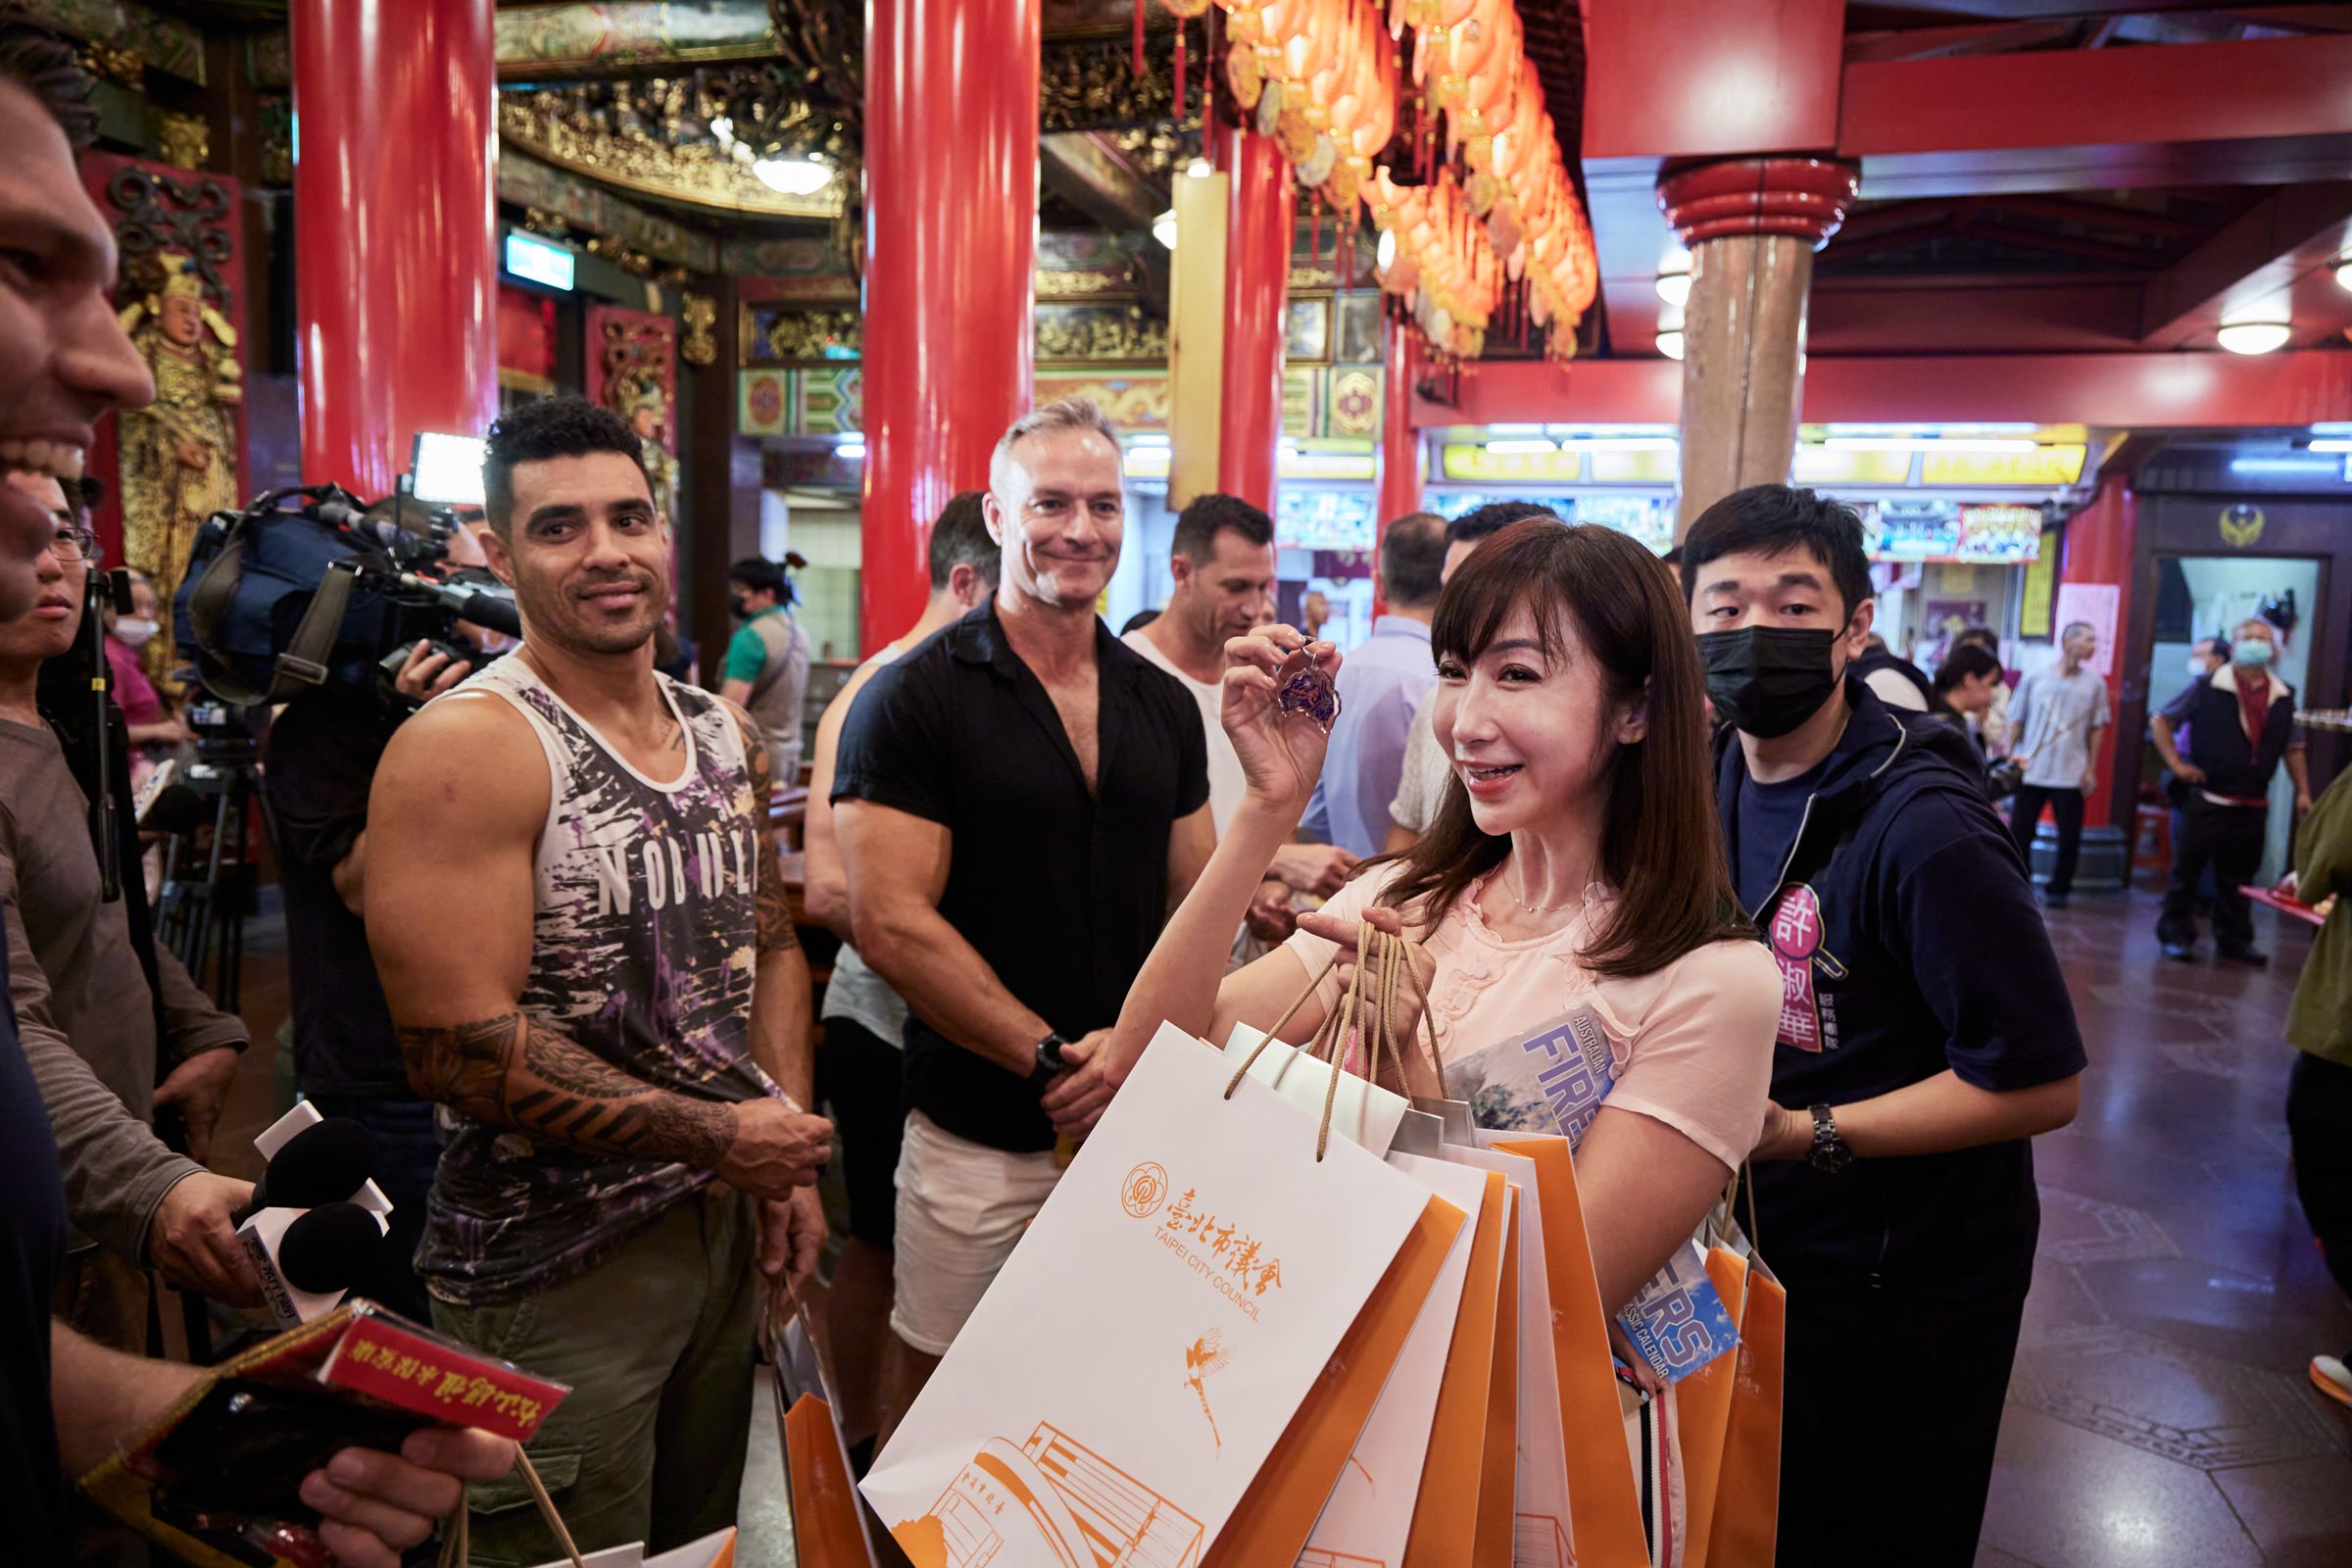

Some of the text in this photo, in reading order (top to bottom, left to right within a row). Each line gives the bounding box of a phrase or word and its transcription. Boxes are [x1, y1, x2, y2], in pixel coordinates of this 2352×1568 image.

[1522, 1022, 1602, 1149] FIRE
[1573, 1014, 1607, 1075] AUSTRALIAN
[1152, 1225, 1261, 1323] TAIPEI CITY COUNCIL
[1166, 1187, 1282, 1297] 臺北市議會
[1623, 1303, 1670, 1380] ASSIC CALENDAR
[1634, 1260, 1713, 1368] ERS
